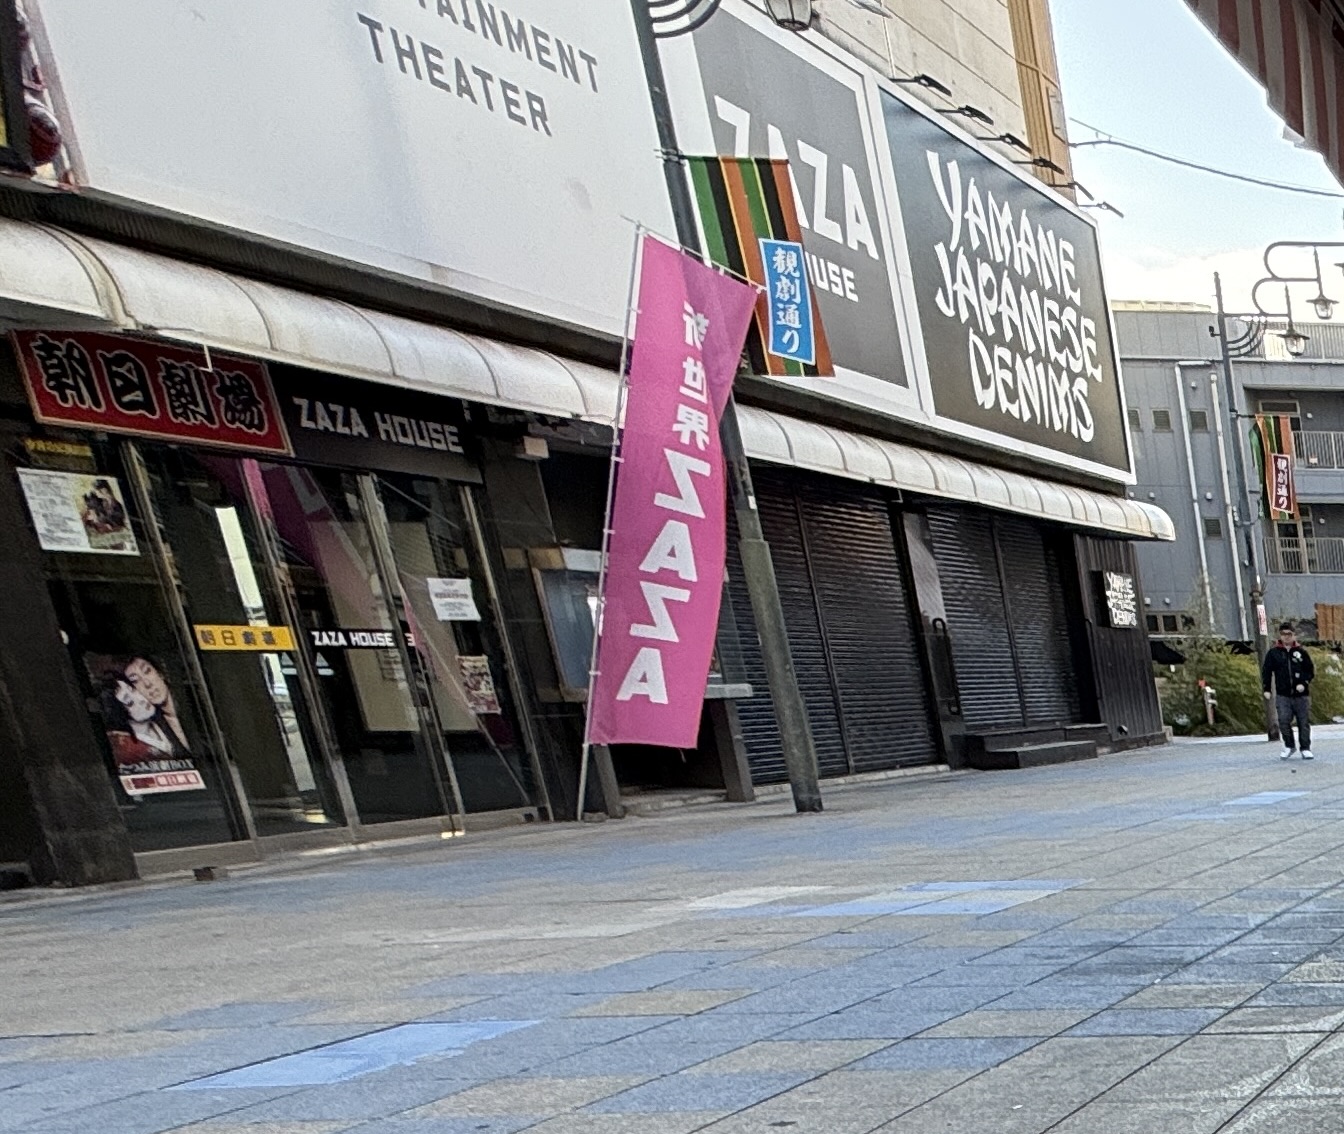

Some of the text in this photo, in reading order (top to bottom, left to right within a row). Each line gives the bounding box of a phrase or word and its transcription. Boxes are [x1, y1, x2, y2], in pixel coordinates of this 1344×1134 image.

[356, 12, 553, 137] THEATER
[418, 0, 599, 93] AINMENT
[805, 250, 859, 303] USE
[926, 149, 1082, 308] YAMANE
[771, 246, 803, 356] 観劇通り
[934, 241, 1104, 384] JAPANESE
[30, 332, 269, 436] 朝日劇場
[292, 395, 465, 454] ZAZA HOUSE
[968, 326, 1095, 443] DENIMS
[311, 630, 395, 648] ZAZA HOUSE
